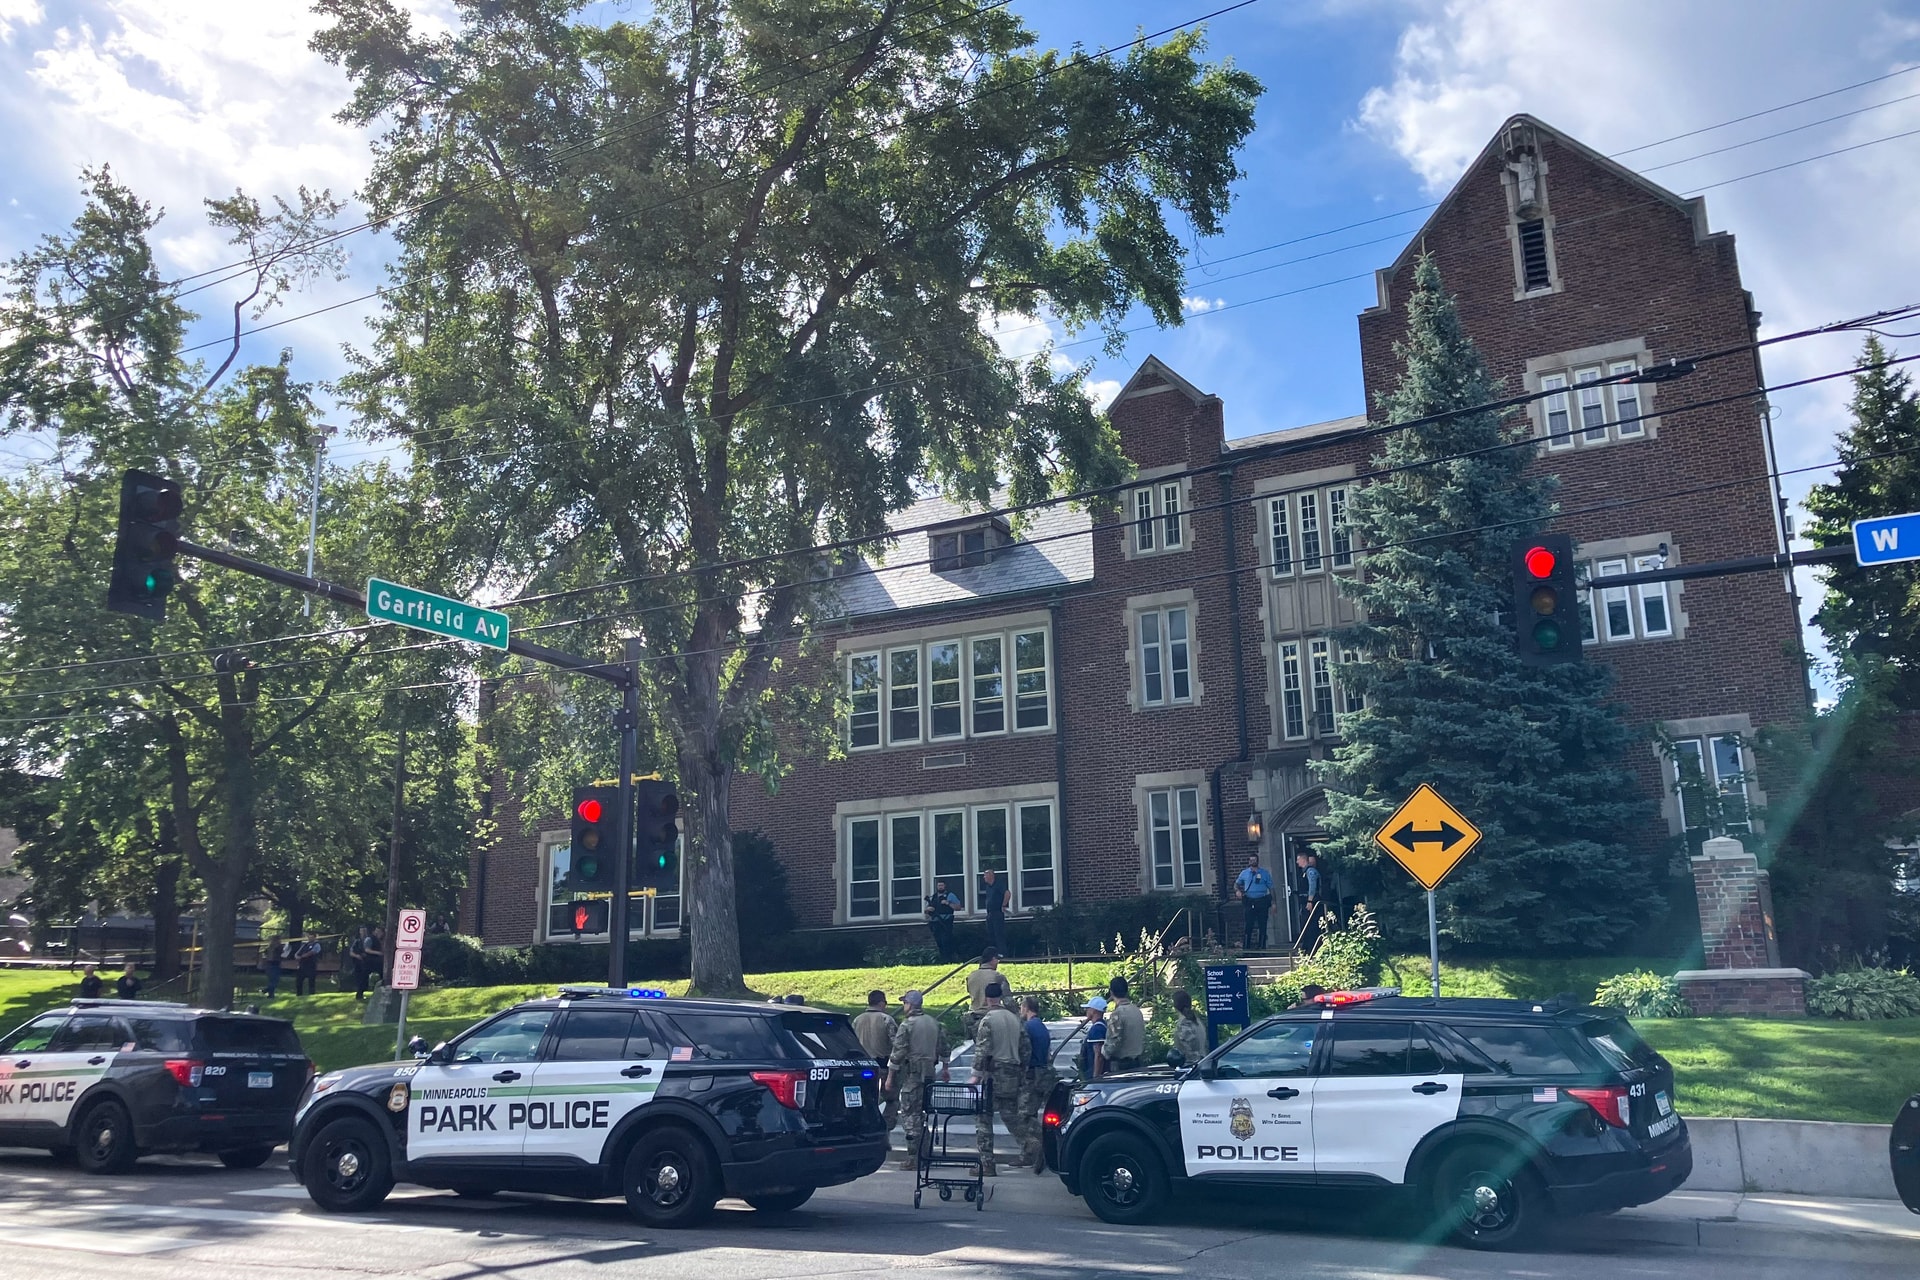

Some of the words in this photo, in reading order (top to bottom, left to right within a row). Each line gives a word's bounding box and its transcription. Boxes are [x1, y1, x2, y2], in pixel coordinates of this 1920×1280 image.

[1871, 527, 1898, 552] W
[377, 590, 464, 630] Garfield
[475, 616, 500, 639] Av
[205, 1066, 226, 1076] 820
[394, 1067, 417, 1077] 850
[810, 1069, 830, 1080] 850
[20, 1081, 76, 1103] POLICE
[422, 1087, 487, 1100] MINNEAPOLIS
[1155, 1084, 1179, 1094] 431
[1629, 1083, 1646, 1097] 431
[420, 1104, 498, 1133] PARK
[508, 1100, 610, 1130] POLICE
[1198, 1145, 1299, 1162] POLICE
